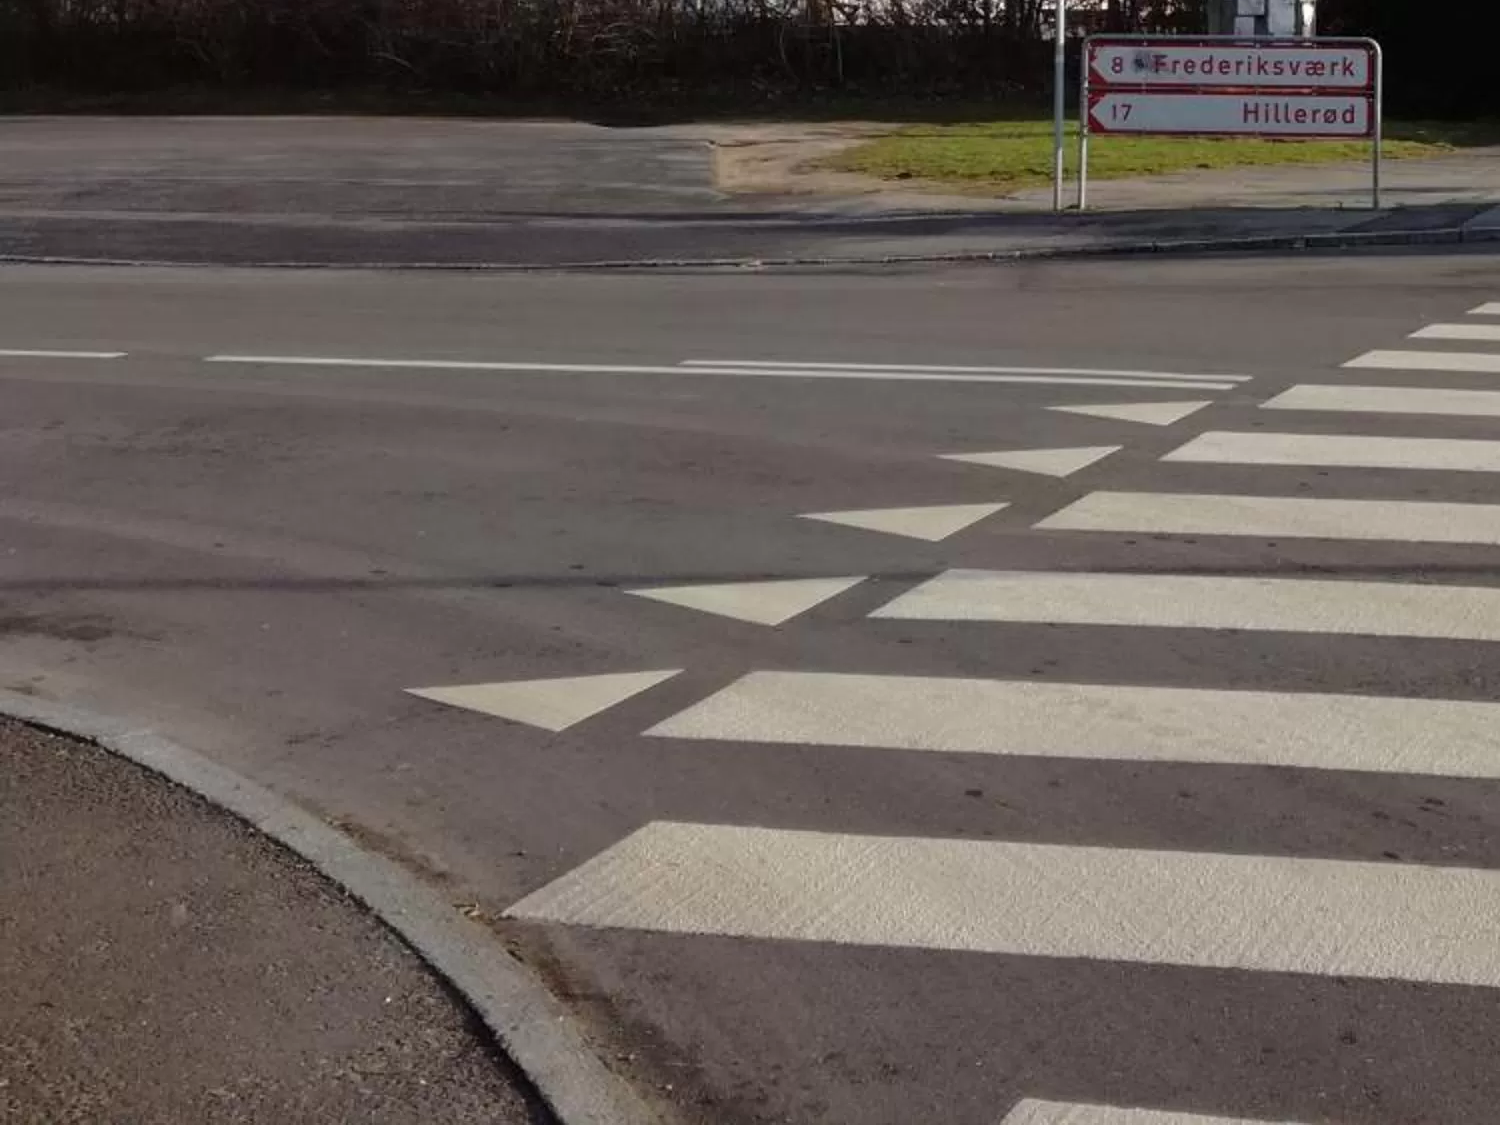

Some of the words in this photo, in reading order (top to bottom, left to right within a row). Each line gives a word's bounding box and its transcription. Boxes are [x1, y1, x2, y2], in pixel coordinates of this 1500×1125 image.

[1111, 56, 1124, 74] 8
[1151, 54, 1355, 77] Frederiksværk
[1111, 104, 1133, 122] 17
[1242, 101, 1356, 124] Hillerød
